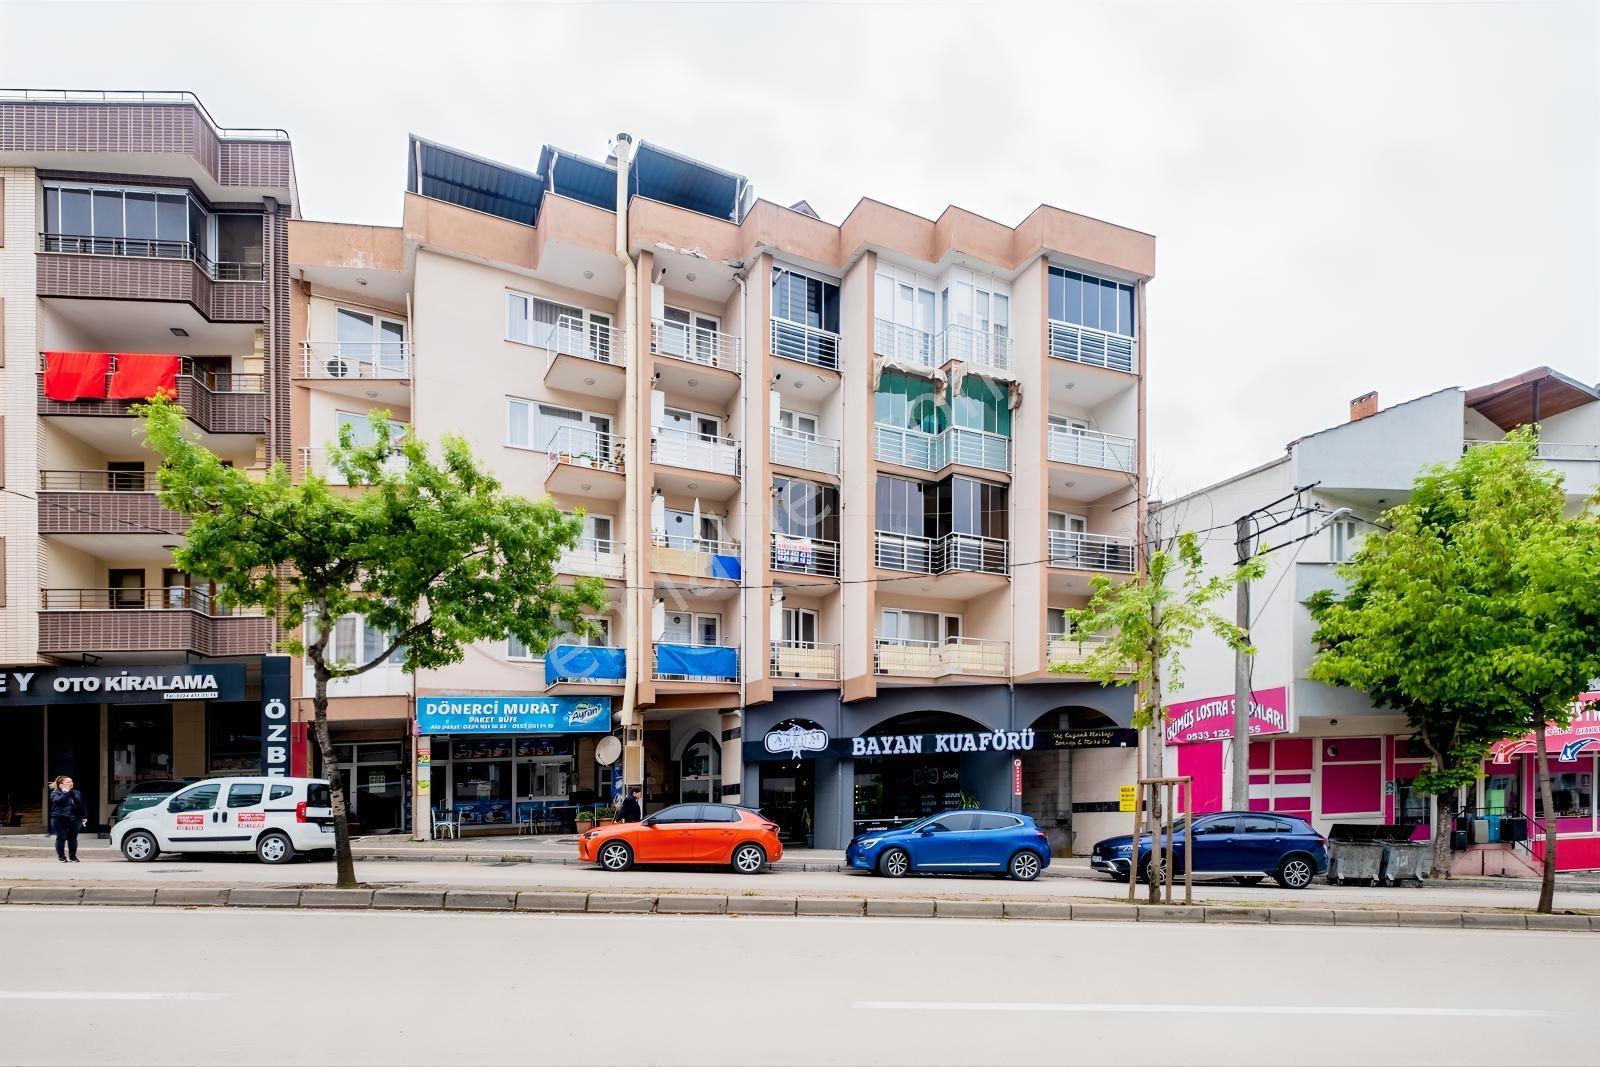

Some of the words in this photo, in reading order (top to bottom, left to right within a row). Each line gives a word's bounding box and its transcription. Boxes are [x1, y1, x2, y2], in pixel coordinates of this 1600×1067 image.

[53, 677, 100, 692] OTO
[105, 671, 218, 691] KİRALAMA
[426, 701, 499, 715] DÖNERCİ
[503, 703, 559, 715] MURAT
[1166, 709, 1194, 741] GÜMÜŞ
[1196, 700, 1229, 722] LOSTRA
[1231, 700, 1284, 730] SONLARI
[852, 735, 923, 756] BAYAN
[935, 729, 1036, 752] KUAFÖRÜ
[1186, 732, 1210, 740] 0533
[1213, 729, 1231, 737] 122
